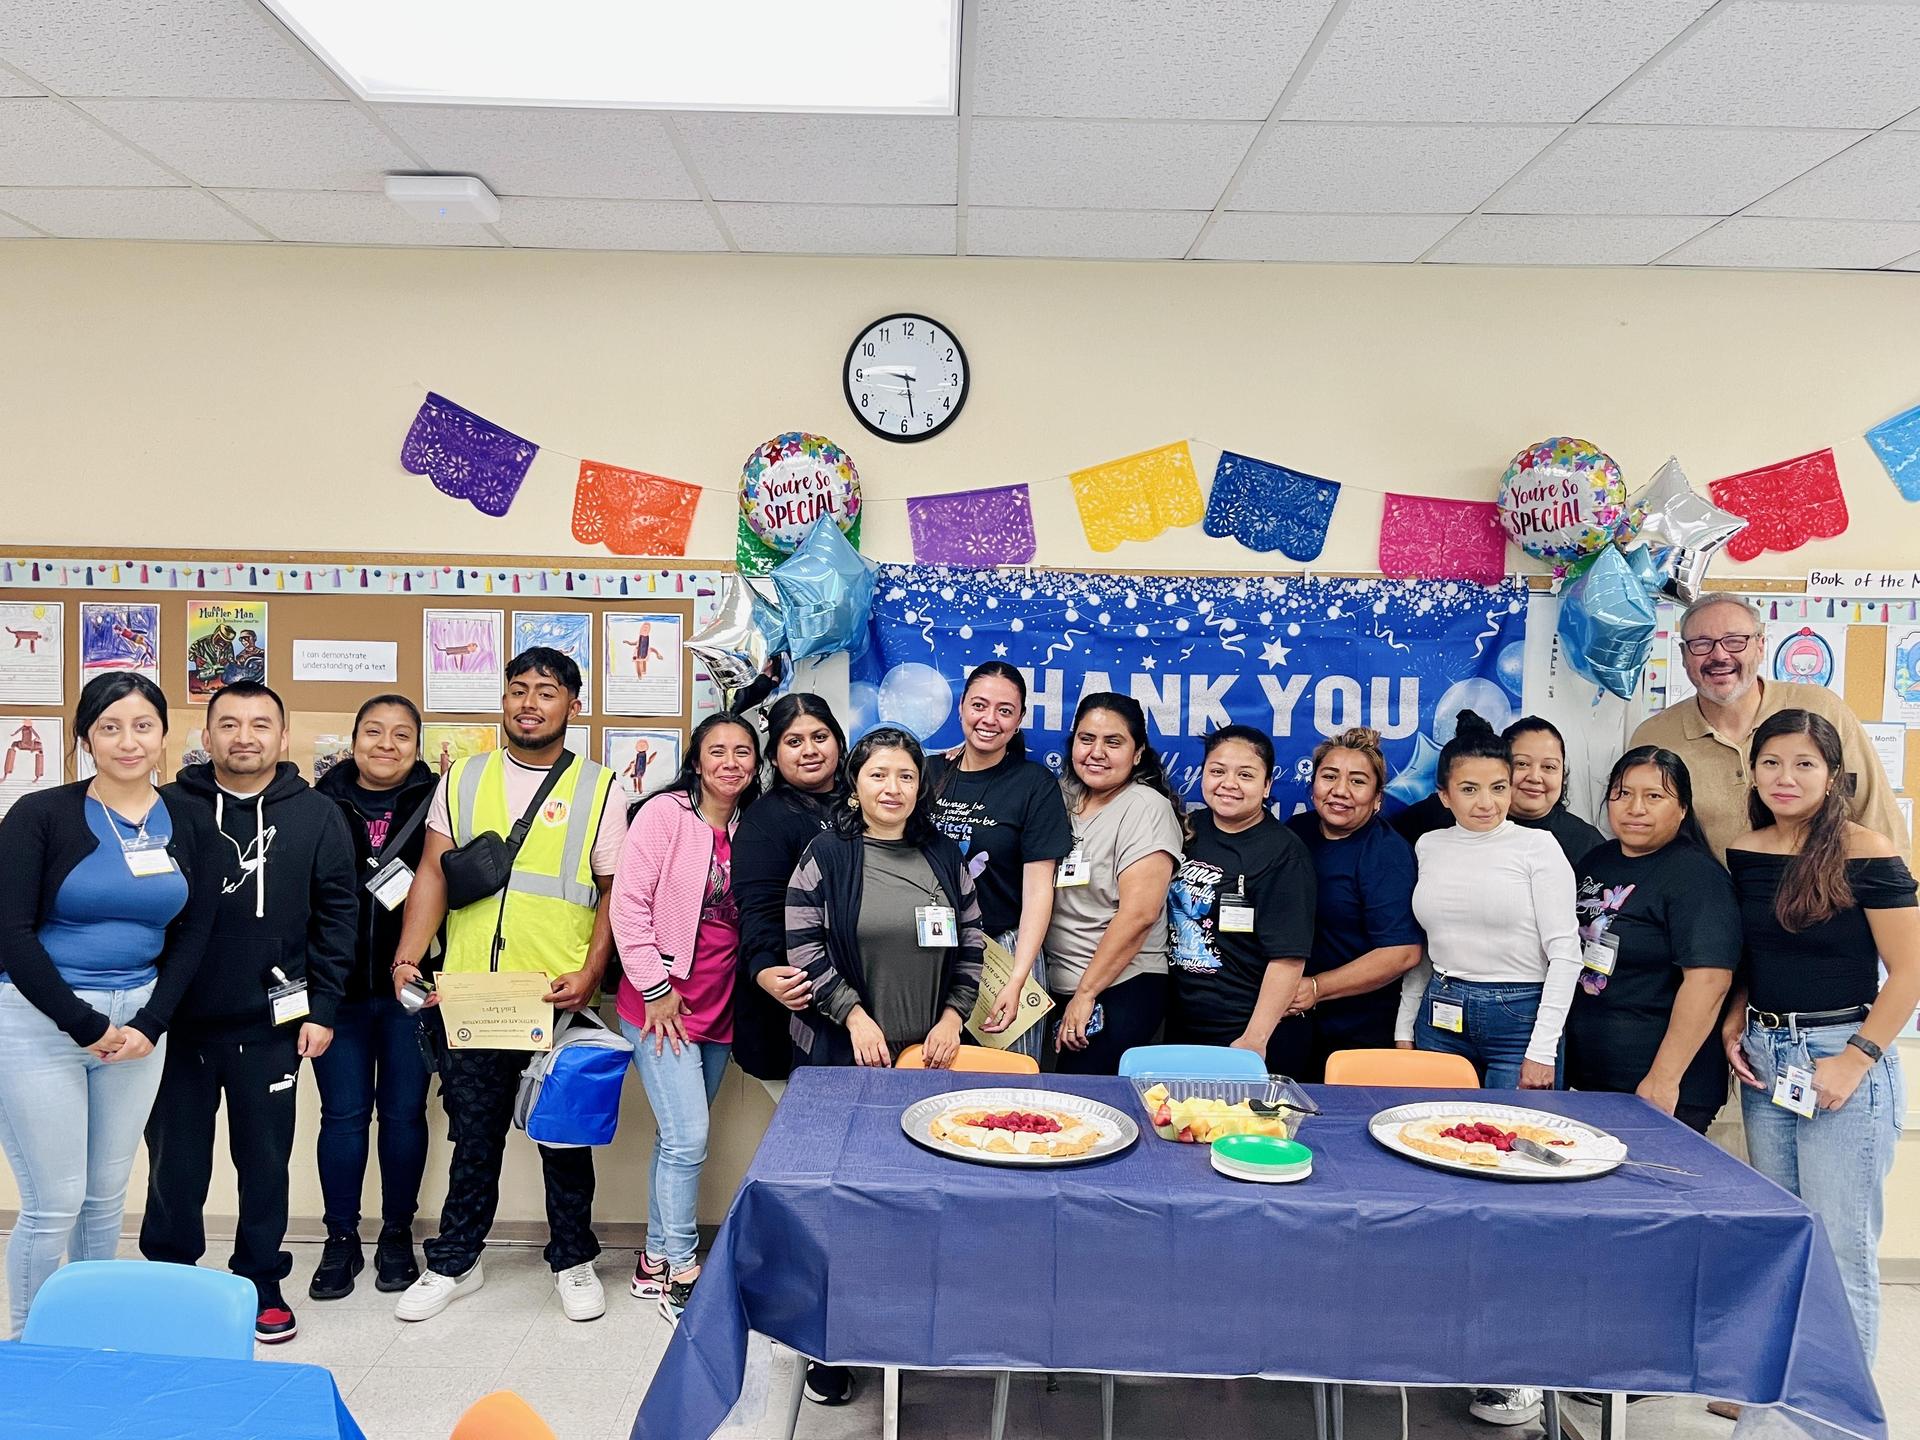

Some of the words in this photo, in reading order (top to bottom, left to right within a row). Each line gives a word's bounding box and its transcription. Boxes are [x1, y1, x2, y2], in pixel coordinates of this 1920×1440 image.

[879, 328, 890, 342] 11
[902, 322, 915, 336] 12
[930, 330, 935, 344] 1
[862, 343, 875, 357] 10
[946, 348, 953, 362] 2
[855, 368, 863, 382] 9
[951, 373, 957, 386] 3
[861, 393, 868, 407] 8
[943, 396, 950, 411] 4
[878, 411, 885, 425] 7
[926, 414, 933, 427] 5
[900, 419, 908, 434] 6
[762, 472, 812, 502] You're
[815, 470, 831, 491] So
[1511, 480, 1559, 509] You're
[1561, 478, 1579, 499] So
[1811, 571, 1845, 587] Book
[1854, 573, 1873, 588] of
[1879, 574, 1905, 588] the
[199, 606, 232, 619] Muffler
[234, 607, 254, 619] Man
[306, 651, 320, 659] can
[321, 650, 368, 660] demonstrate
[302, 661, 354, 673] understanding
[354, 662, 363, 671] of
[963, 664, 1241, 738] HANK
[1257, 673, 1421, 740] YOU
[936, 798, 970, 810] Always
[971, 801, 986, 812] be
[962, 816, 982, 824] can
[982, 815, 998, 827] be
